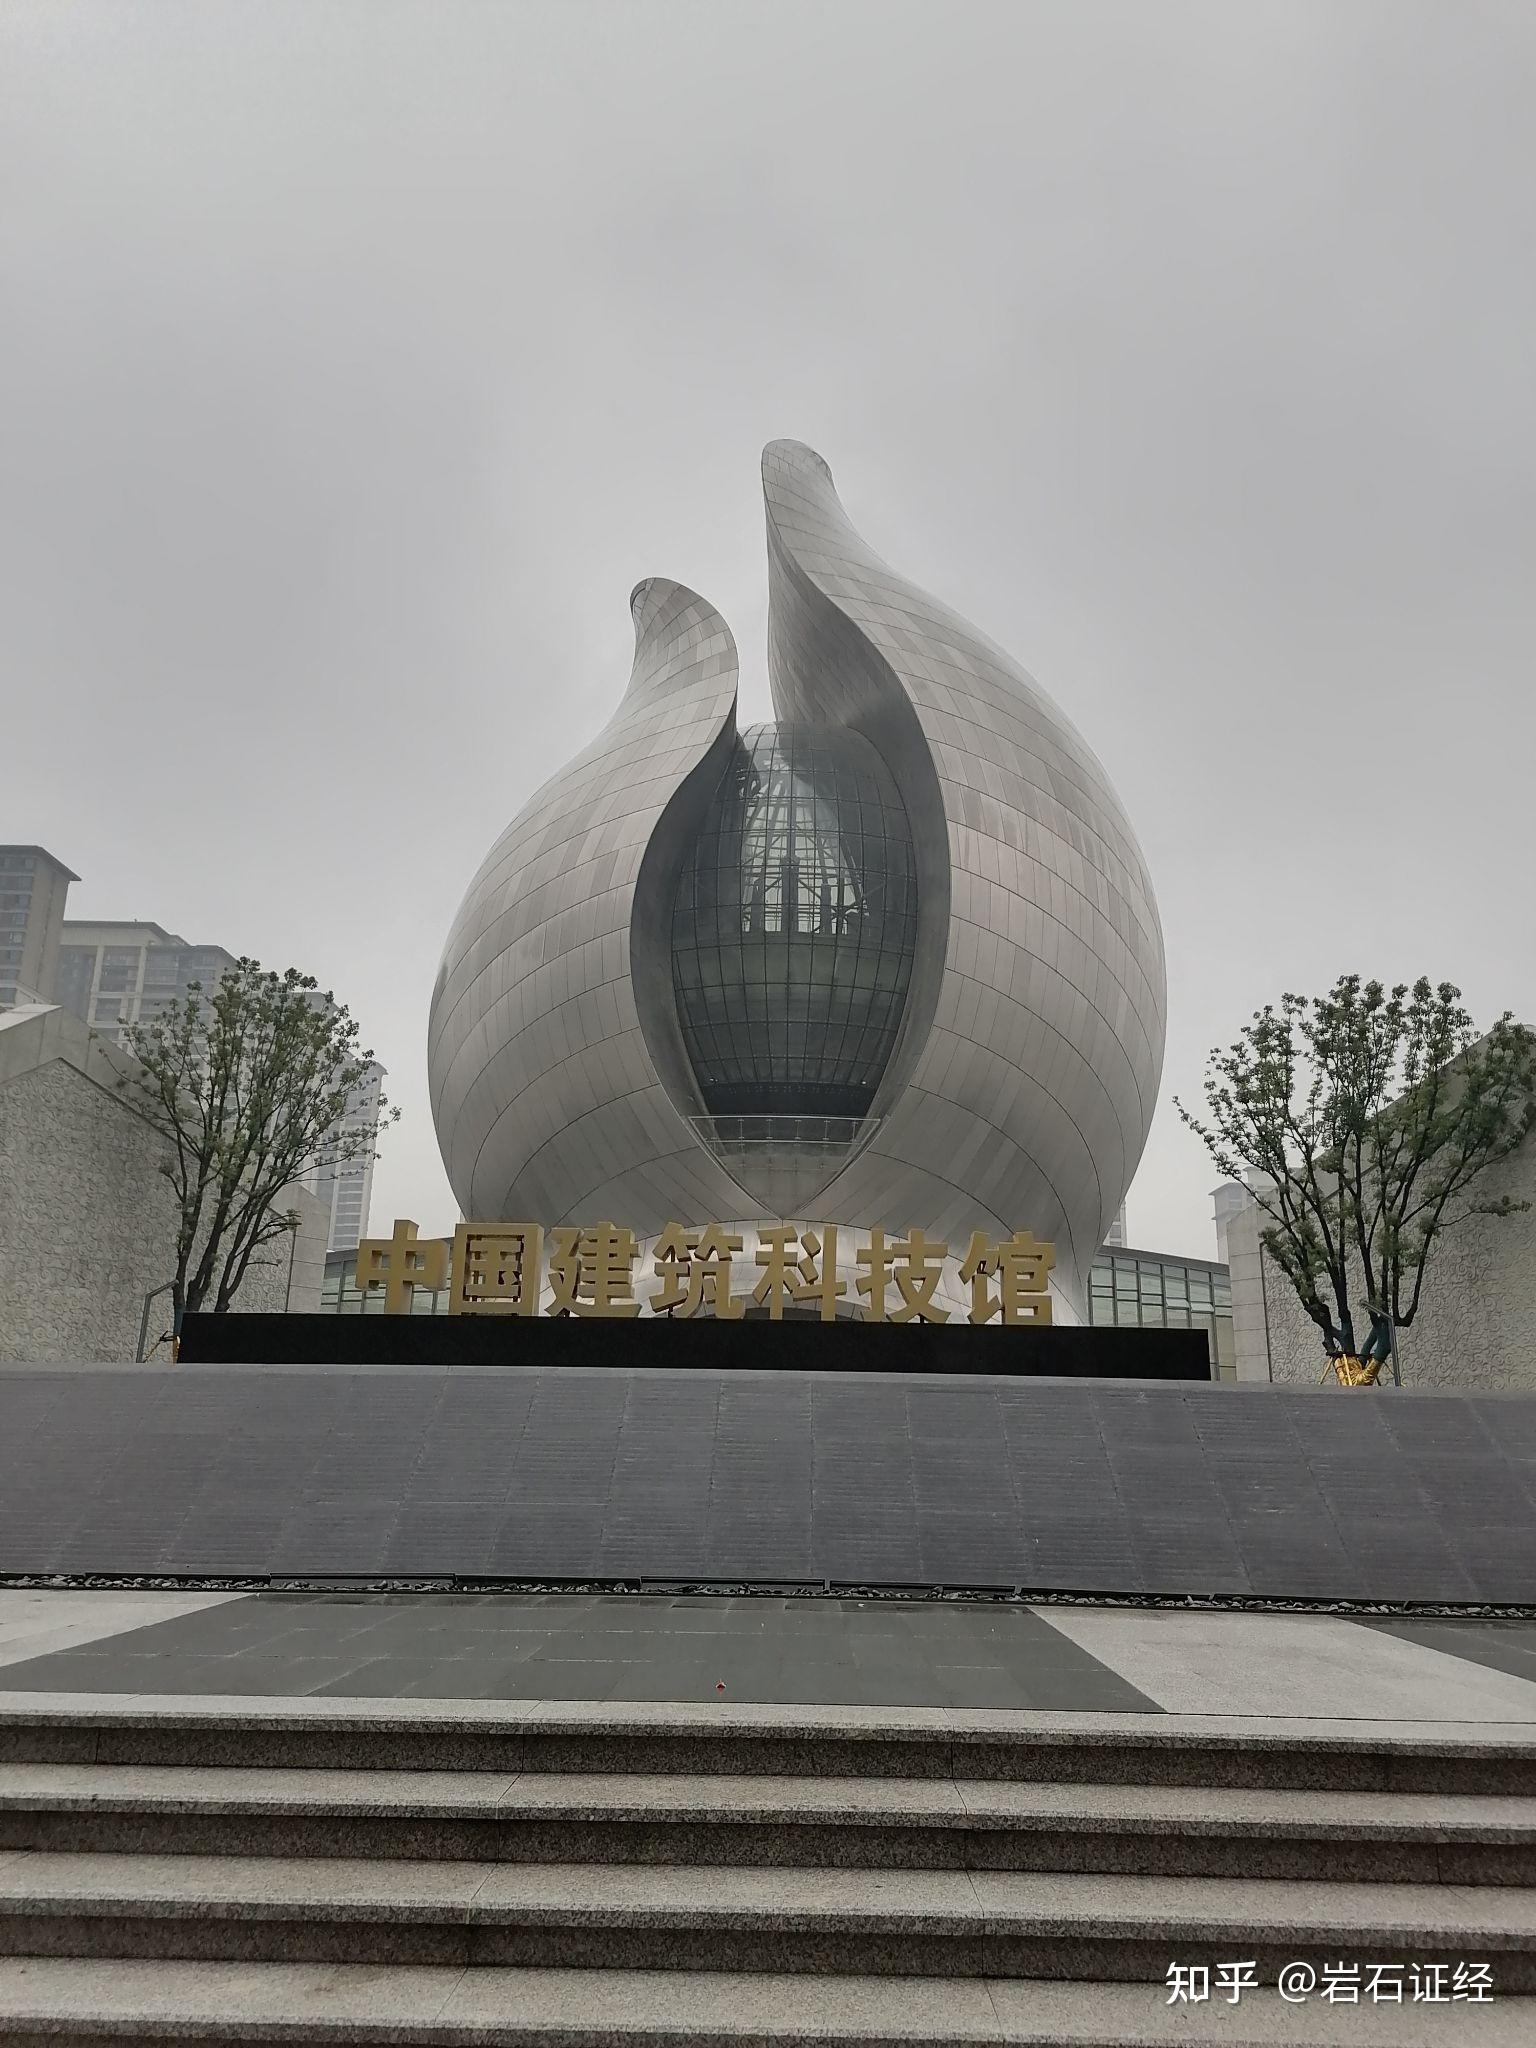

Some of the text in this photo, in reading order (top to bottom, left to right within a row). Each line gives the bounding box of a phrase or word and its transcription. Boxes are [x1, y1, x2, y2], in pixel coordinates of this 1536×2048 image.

[355, 1219, 1056, 1325] 中国建筑科技馆
